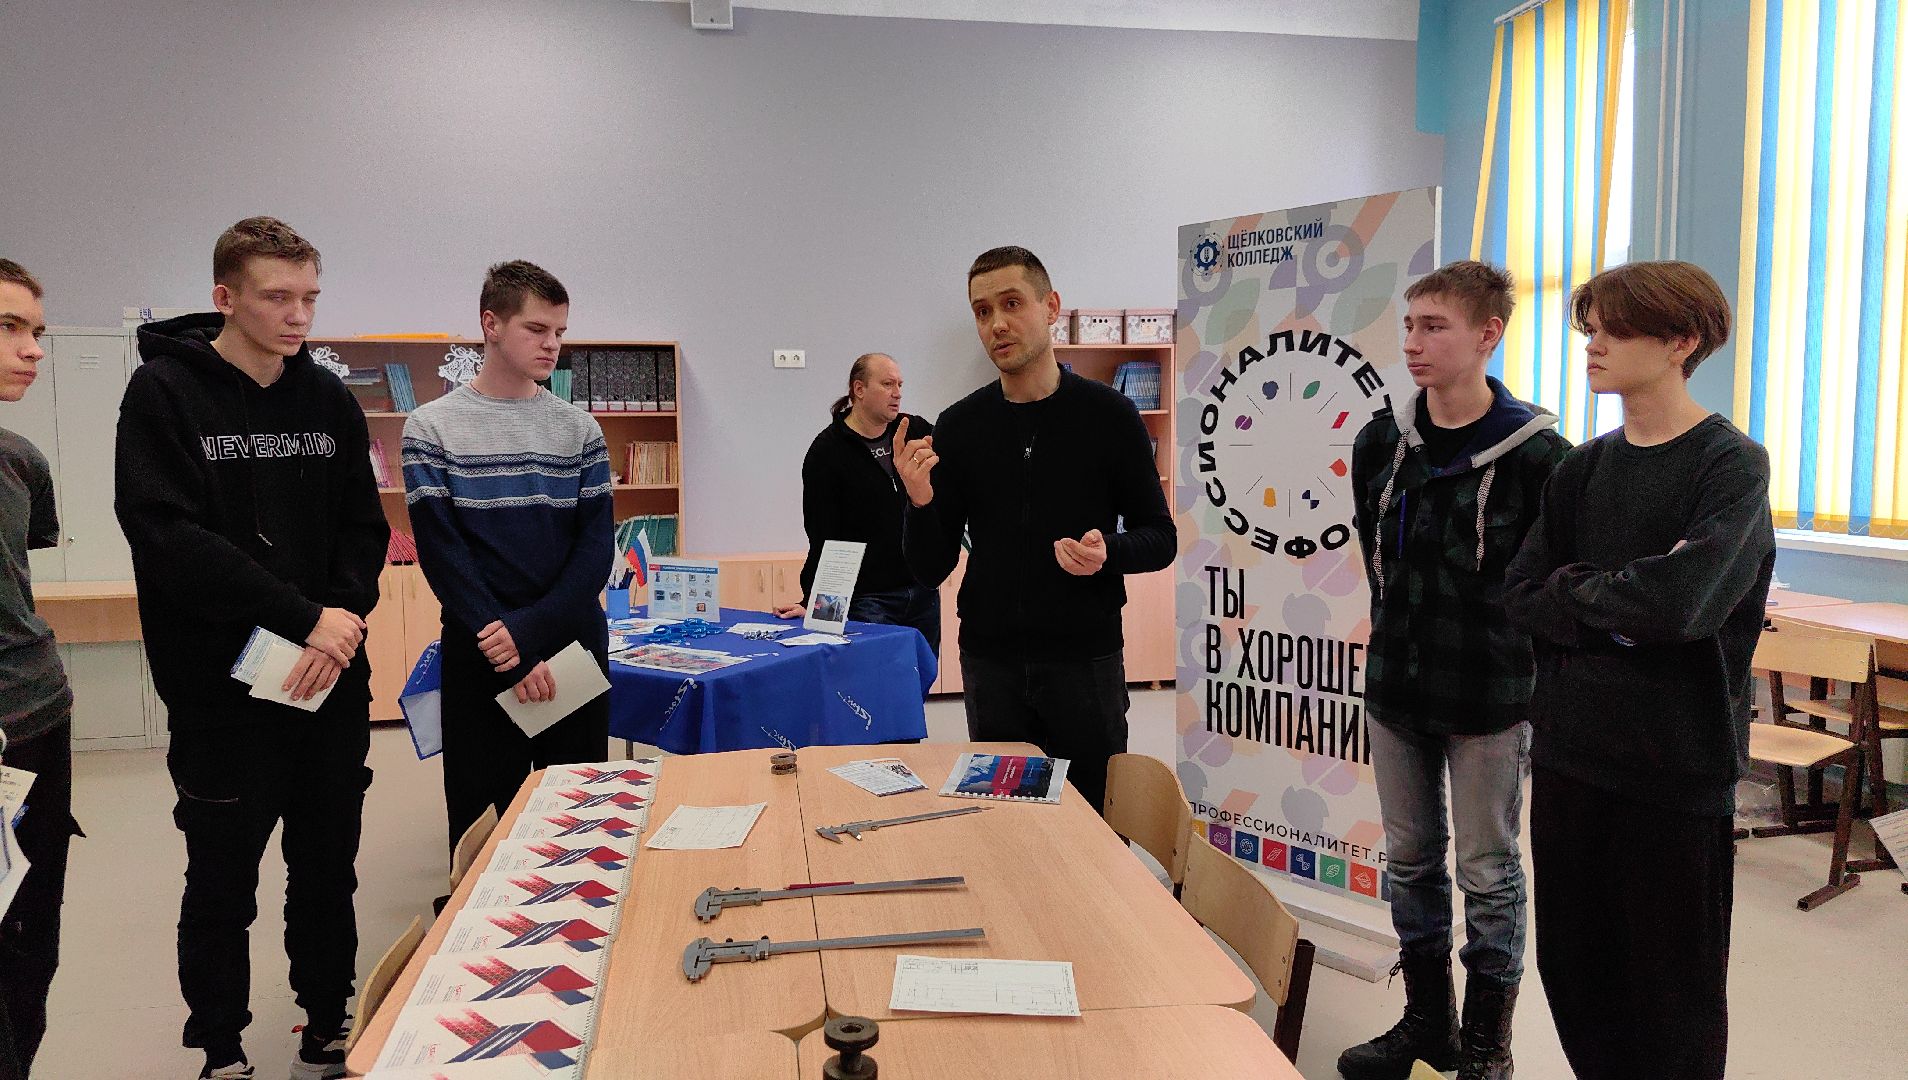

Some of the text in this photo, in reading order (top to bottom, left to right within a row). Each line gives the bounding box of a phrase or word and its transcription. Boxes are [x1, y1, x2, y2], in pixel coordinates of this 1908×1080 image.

[1228, 218, 1323, 250] ЩЁЛКОВСКИЙ
[1228, 245, 1294, 268] КОЛЛЕДЖ
[199, 432, 336, 461] NEVERMIND
[1197, 329, 1394, 559] ОФЕССИОНАЛИТЕТ
[1204, 565, 1245, 620] ТЫ
[1205, 624, 1370, 699] В ХОРОШЕ
